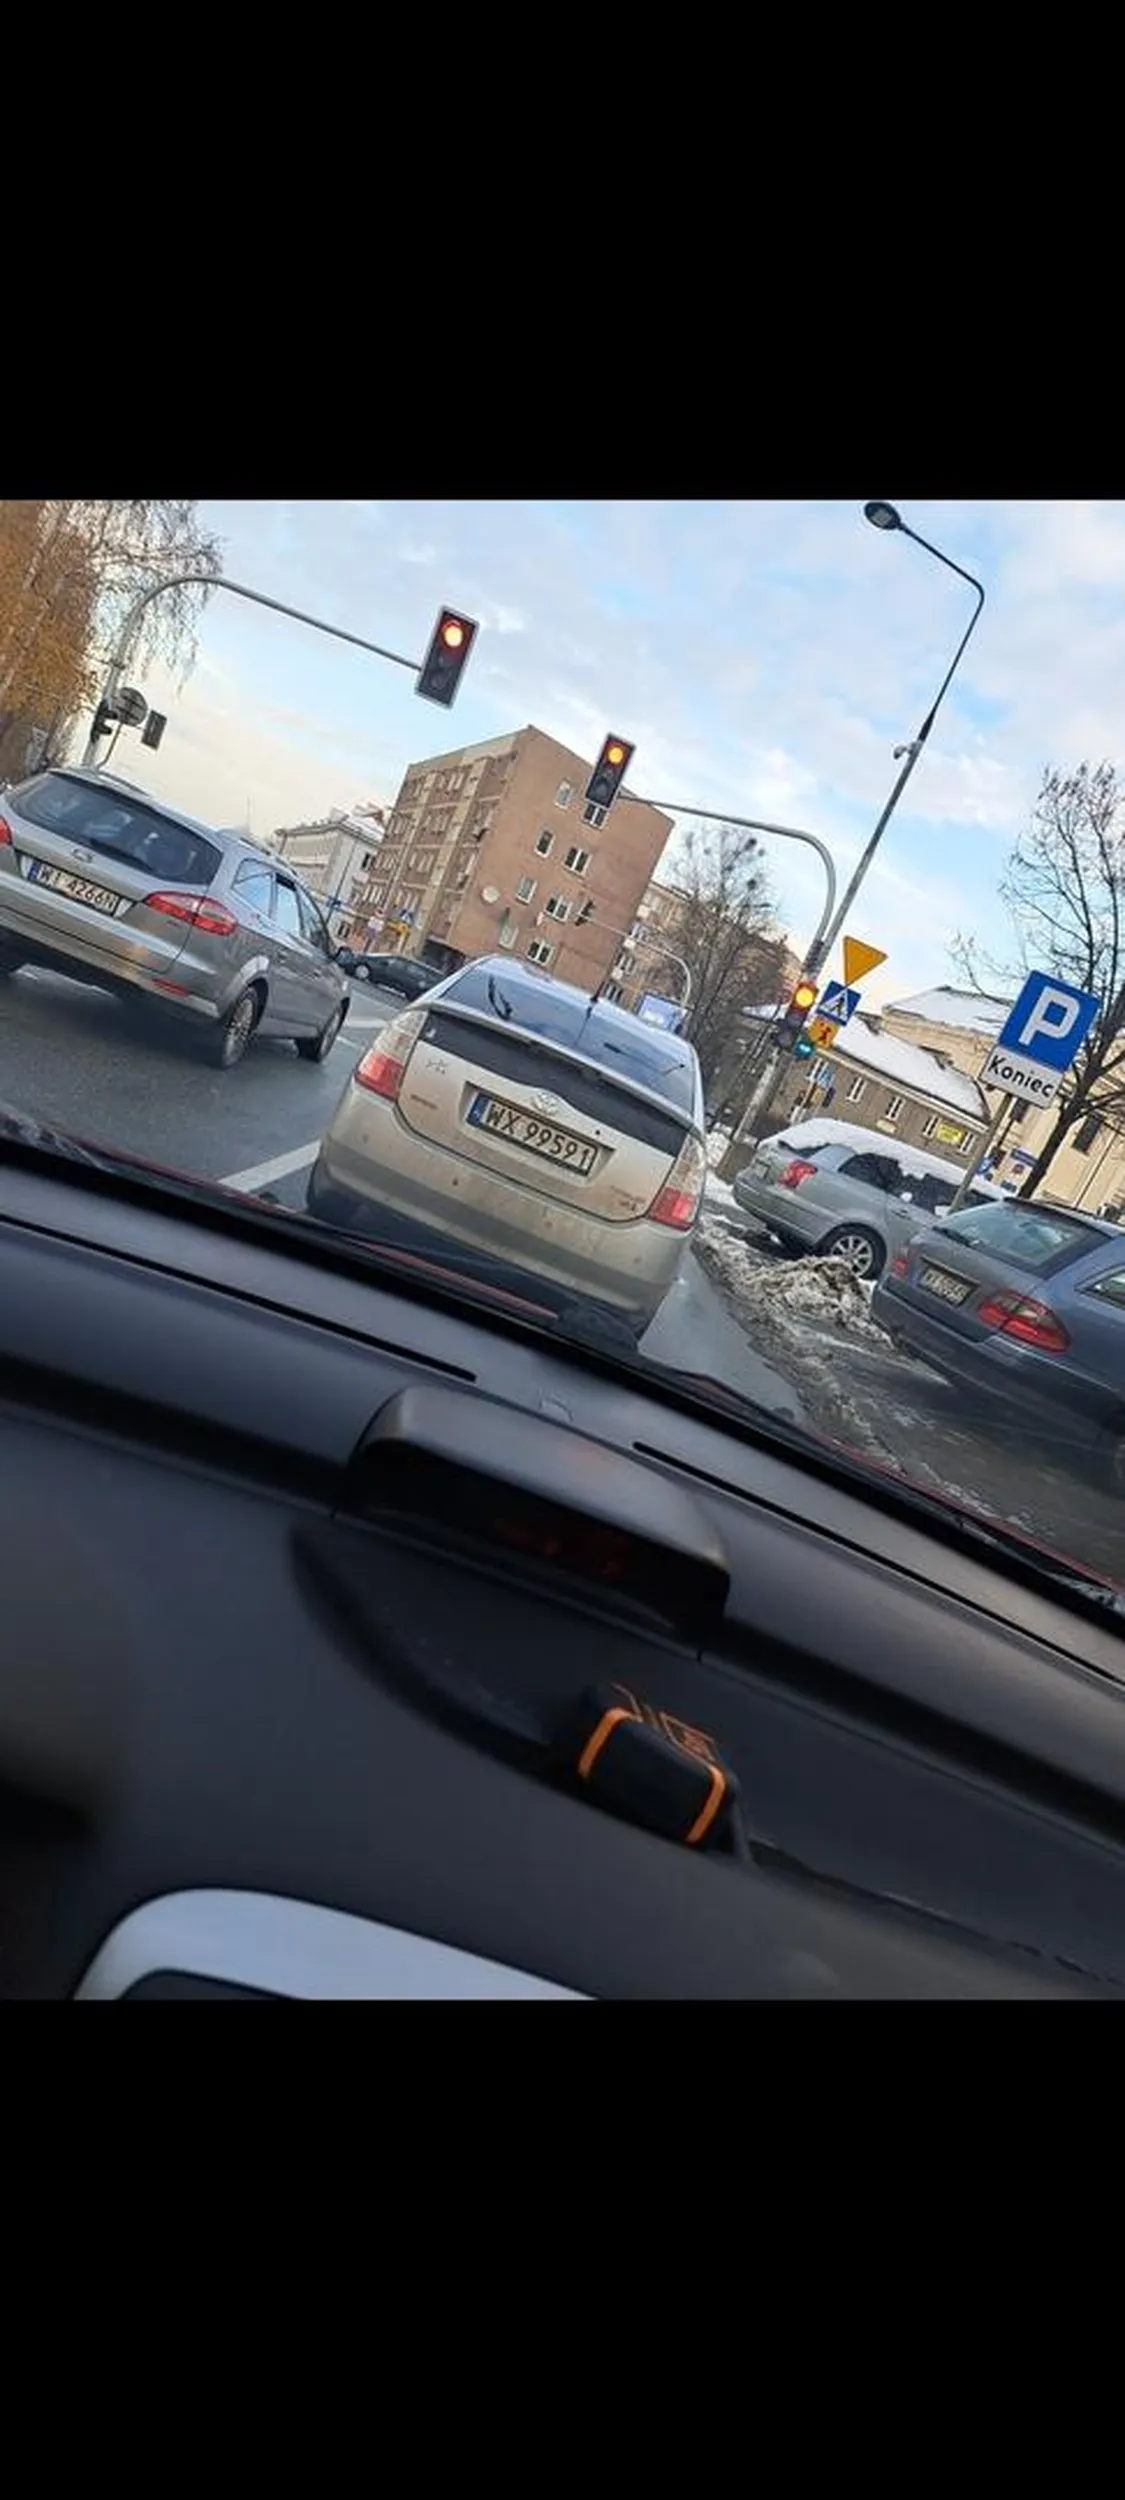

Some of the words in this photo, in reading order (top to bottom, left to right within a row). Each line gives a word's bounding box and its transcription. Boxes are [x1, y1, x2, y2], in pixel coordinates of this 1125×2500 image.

[1018, 985, 1080, 1046] P
[987, 1055, 1054, 1098] Koniec
[486, 1103, 520, 1134] WX
[523, 1122, 590, 1167] 99591
